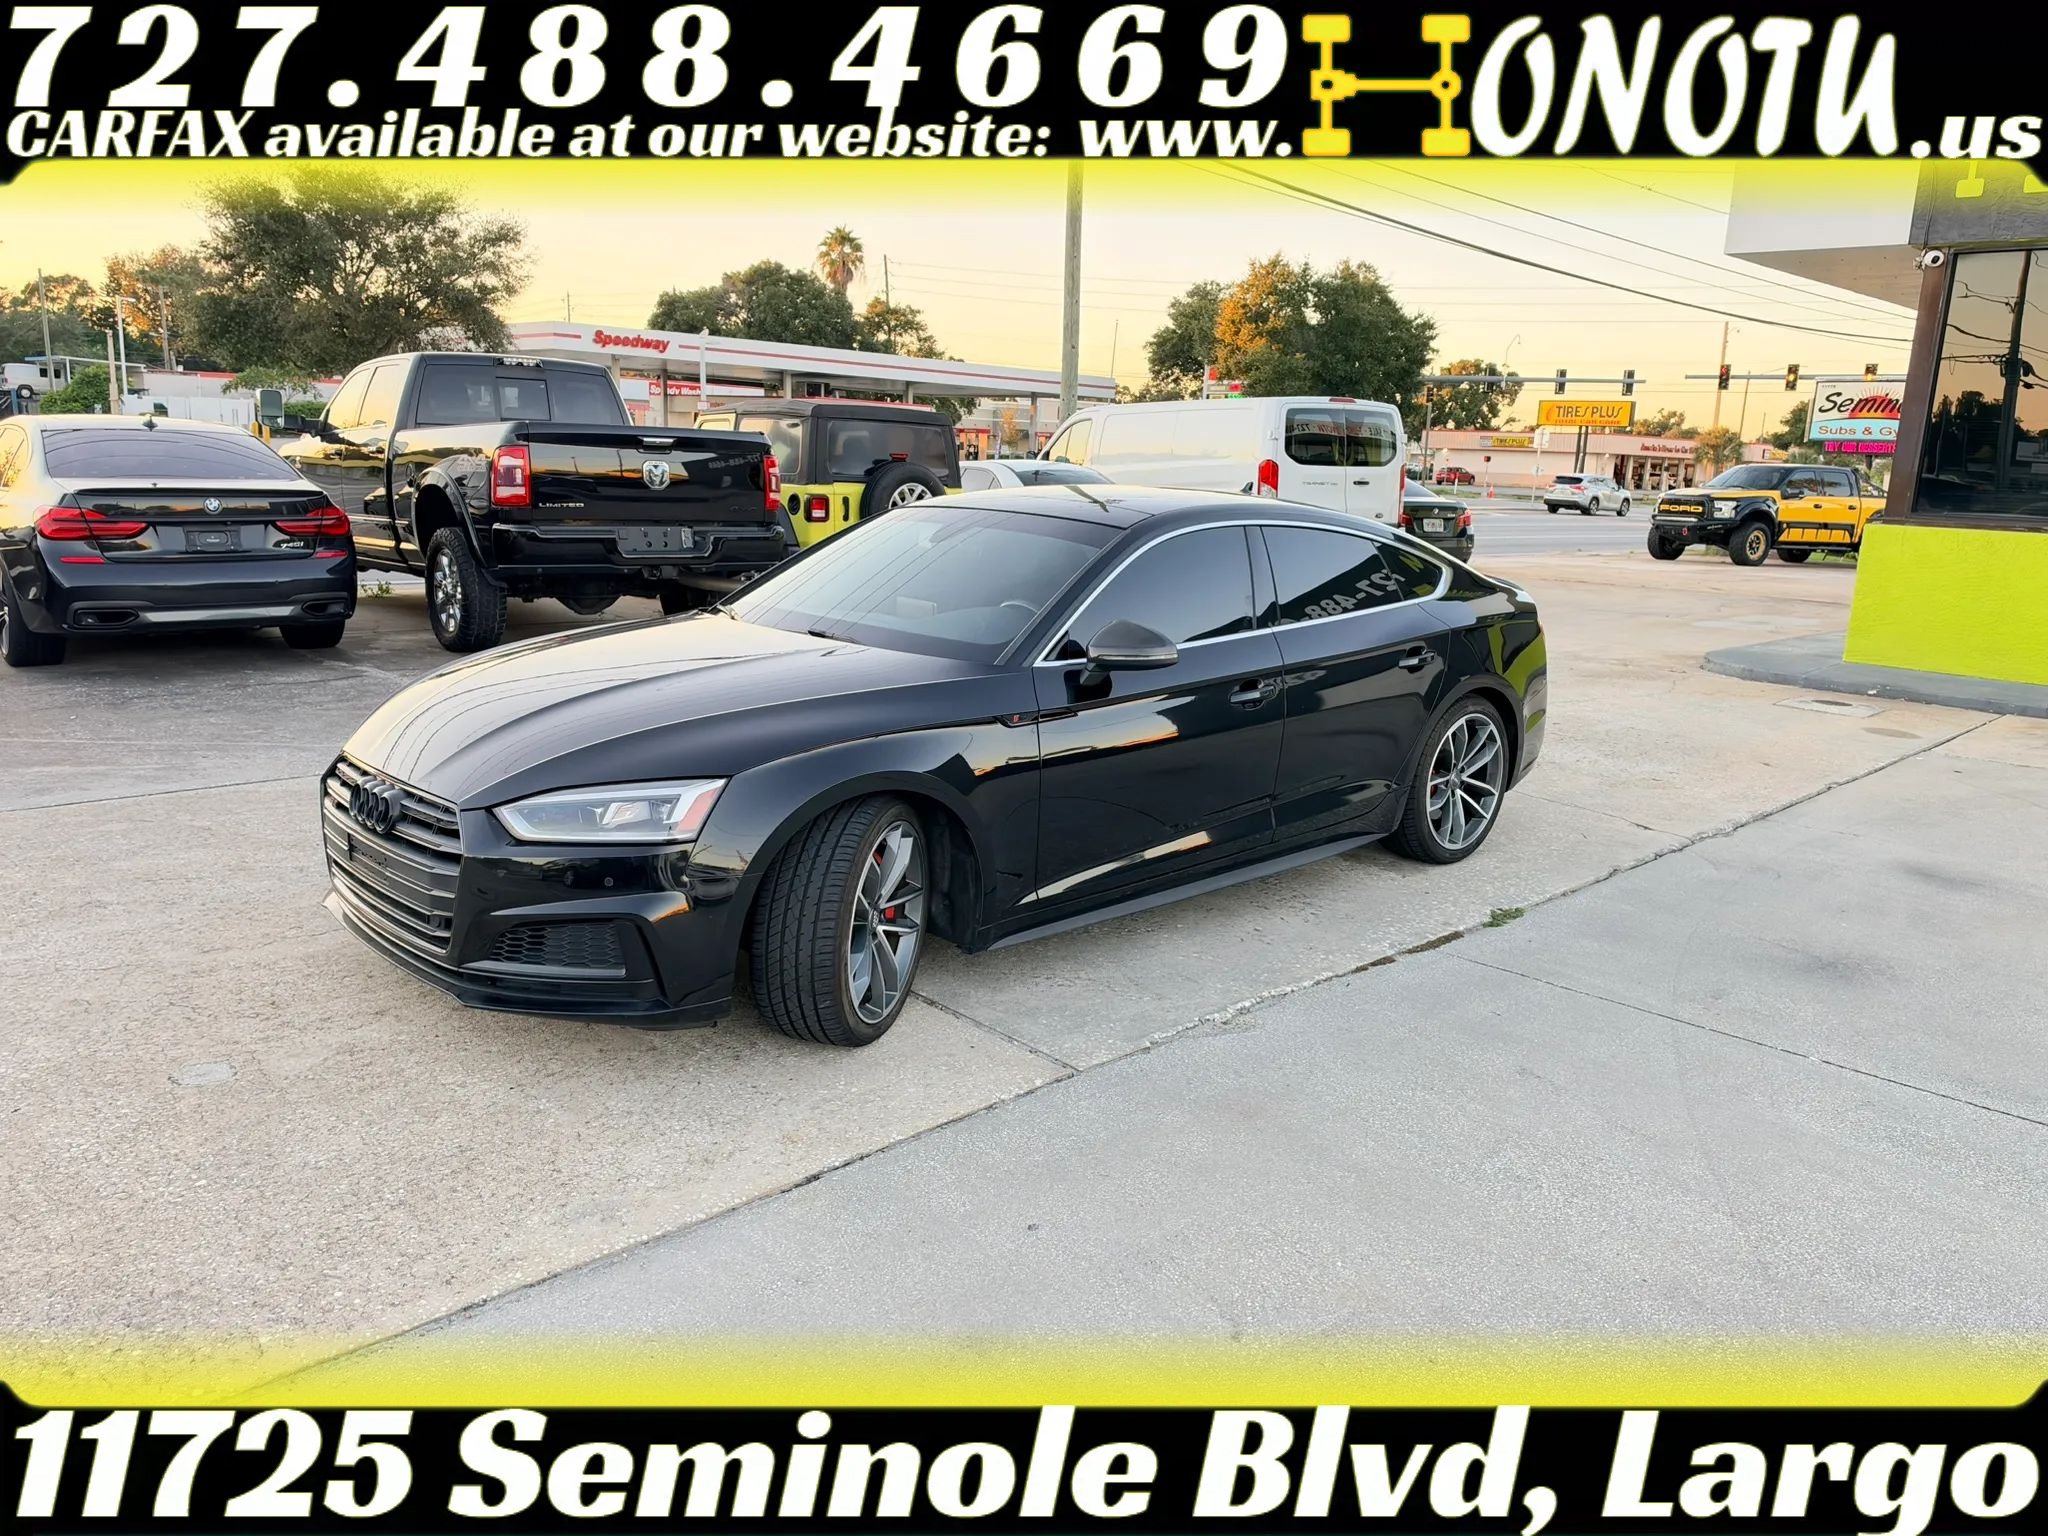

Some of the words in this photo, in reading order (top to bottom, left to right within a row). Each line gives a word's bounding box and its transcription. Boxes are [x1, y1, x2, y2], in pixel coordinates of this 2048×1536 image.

[593, 330, 670, 353] Speedway
[1818, 391, 1902, 413] Semin
[1818, 425, 1857, 435] Subs
[1862, 426, 1873, 435] &
[1659, 504, 1703, 513] FORD
